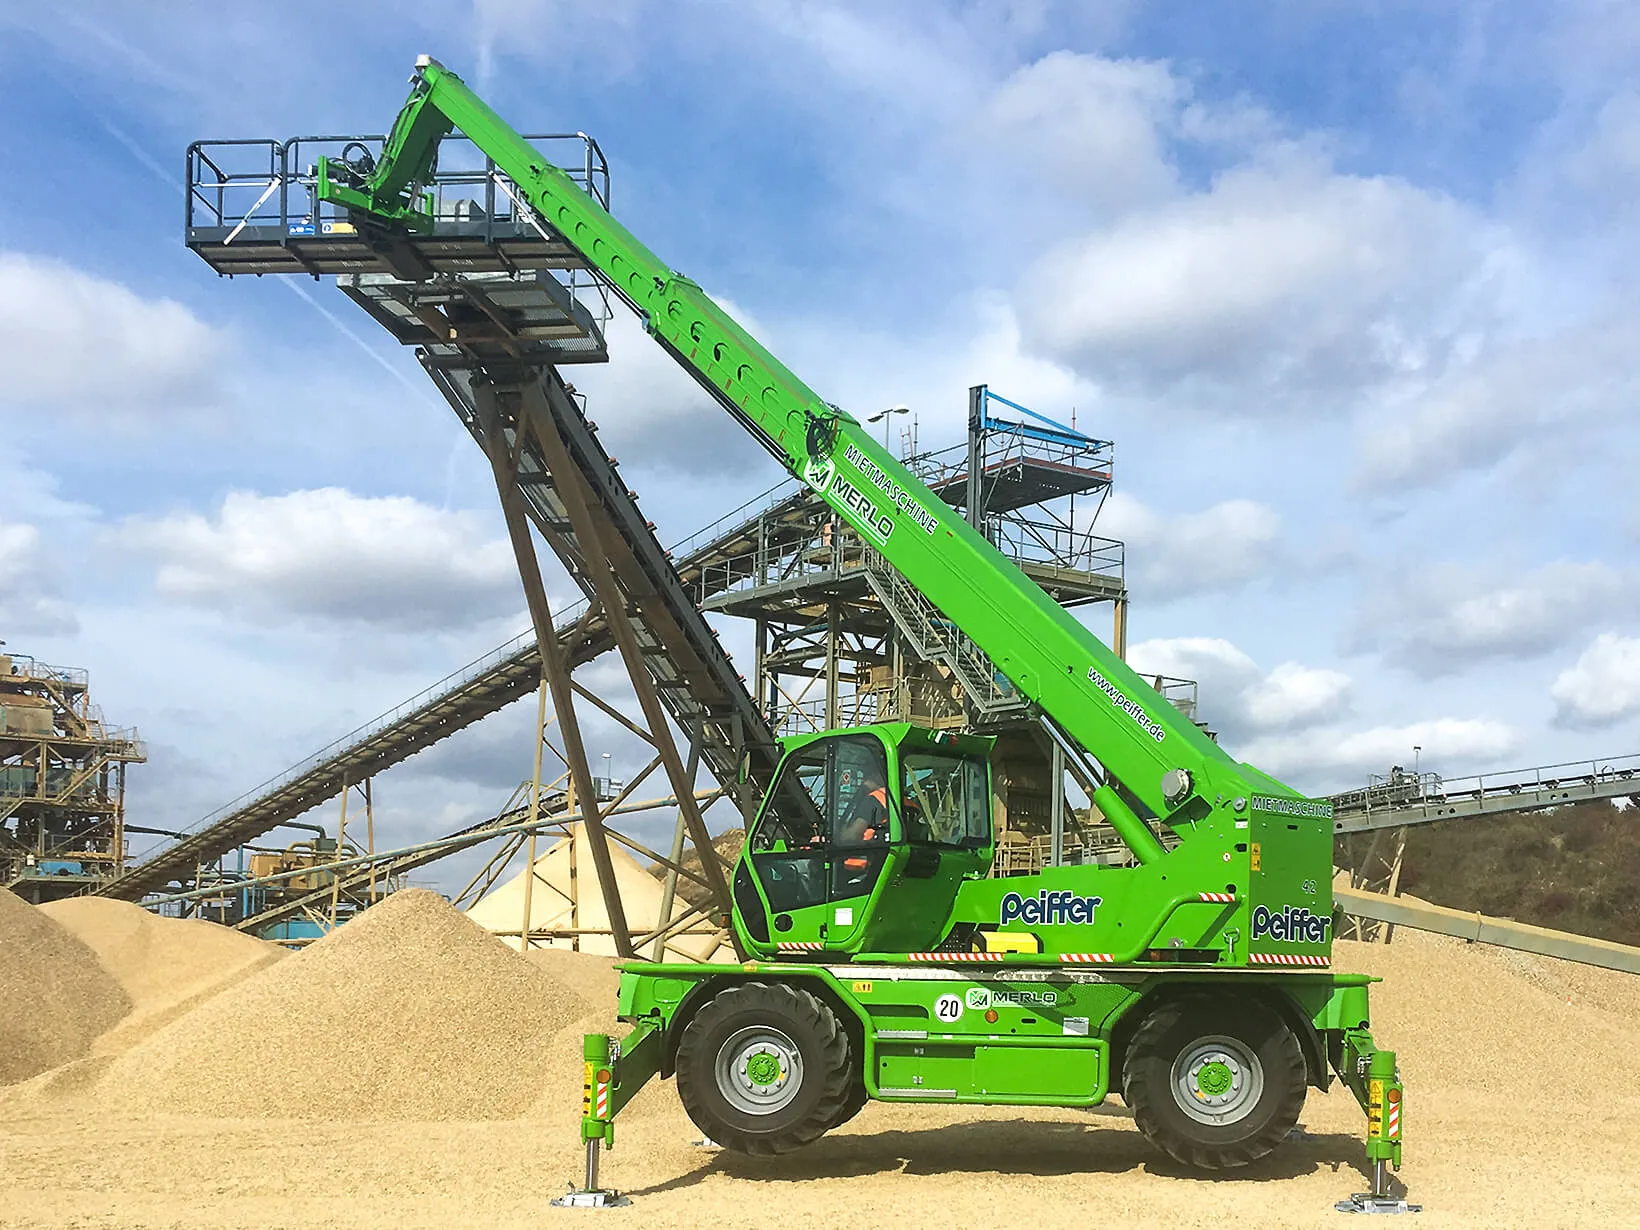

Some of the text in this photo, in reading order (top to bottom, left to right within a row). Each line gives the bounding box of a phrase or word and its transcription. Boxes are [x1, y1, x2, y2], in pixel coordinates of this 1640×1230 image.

[843, 444, 938, 535] MIETMASCHINE
[831, 474, 894, 538] MERLO
[1087, 666, 1165, 742] www.peiffer.de
[1251, 795, 1333, 819] MIETMASCHINE
[1301, 879, 1316, 895] 42
[939, 1000, 959, 1018] 20
[992, 991, 1057, 1003] MERLO
